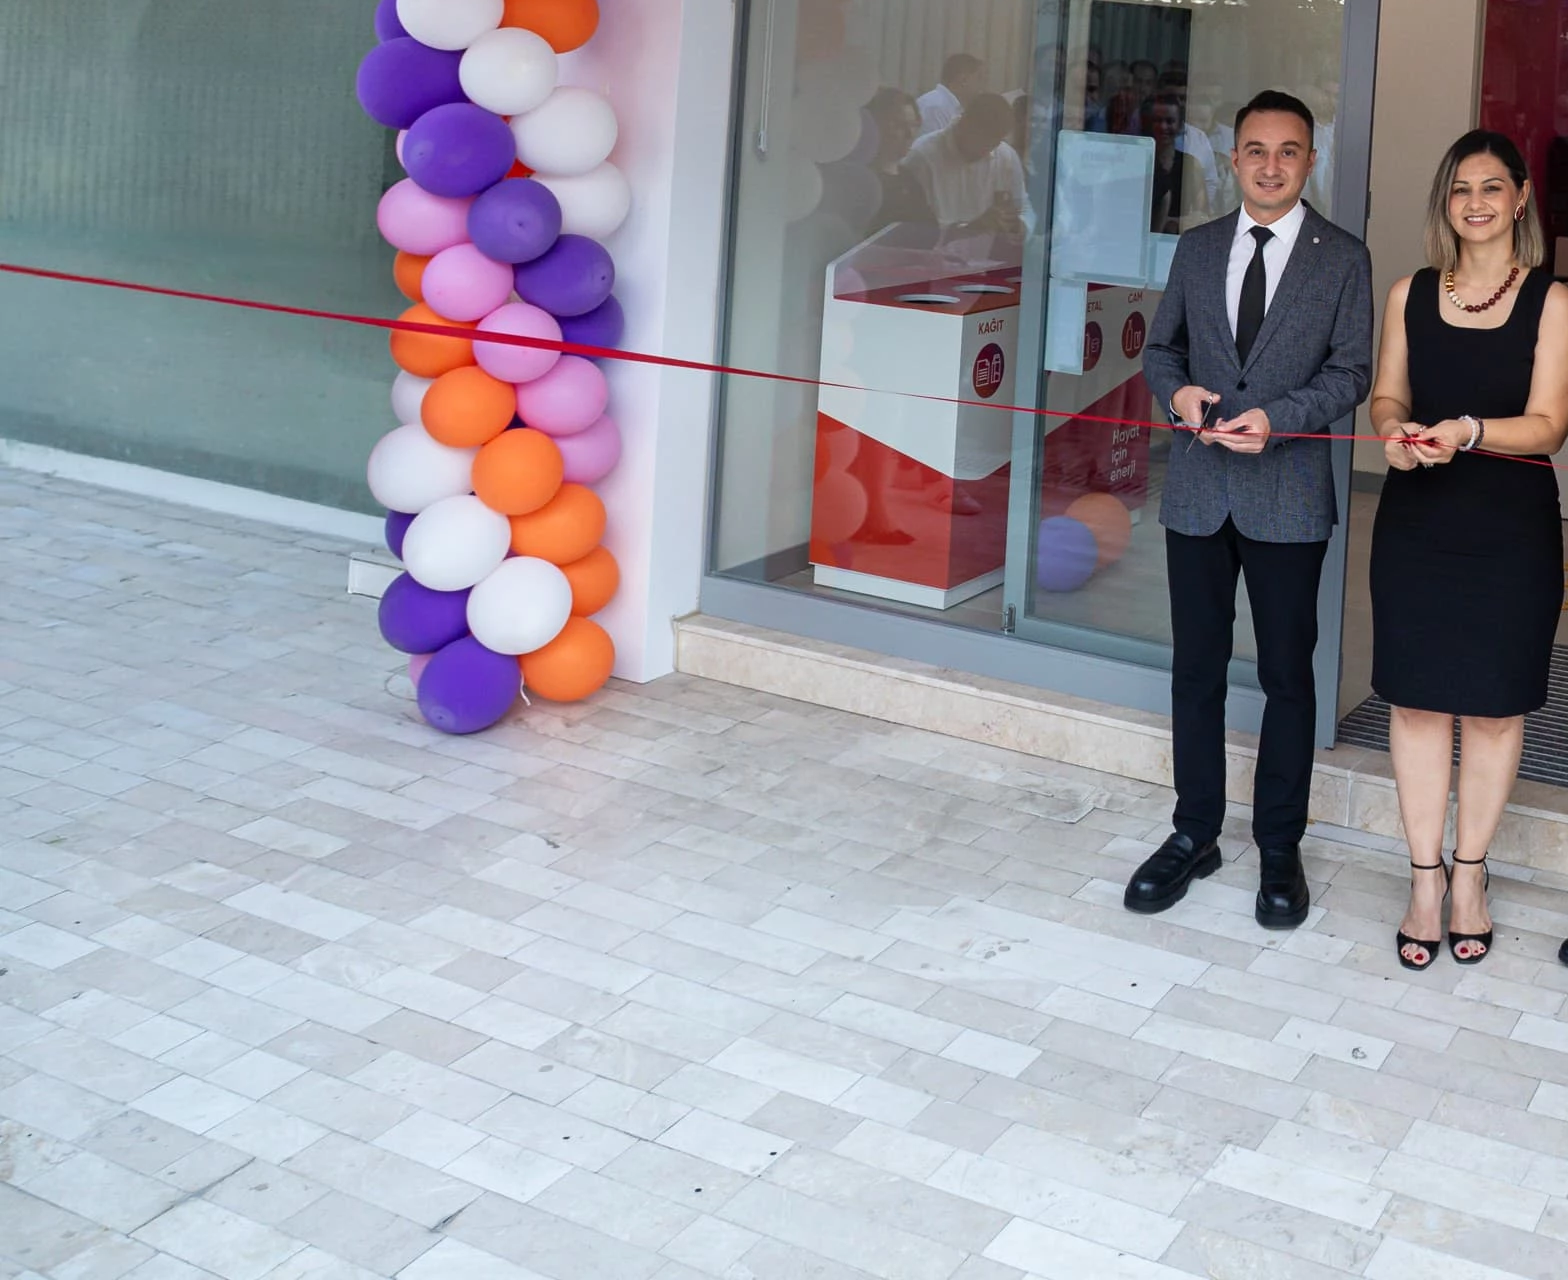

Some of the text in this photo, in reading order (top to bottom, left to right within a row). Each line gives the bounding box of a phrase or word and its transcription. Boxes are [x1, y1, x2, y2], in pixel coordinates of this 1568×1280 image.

[1127, 291, 1143, 304] CAM
[1087, 301, 1103, 313] ETAL
[978, 318, 1005, 335] KAĞIT
[1112, 423, 1140, 445] Hayat
[1111, 447, 1128, 466] için
[1110, 460, 1136, 481] enerji
